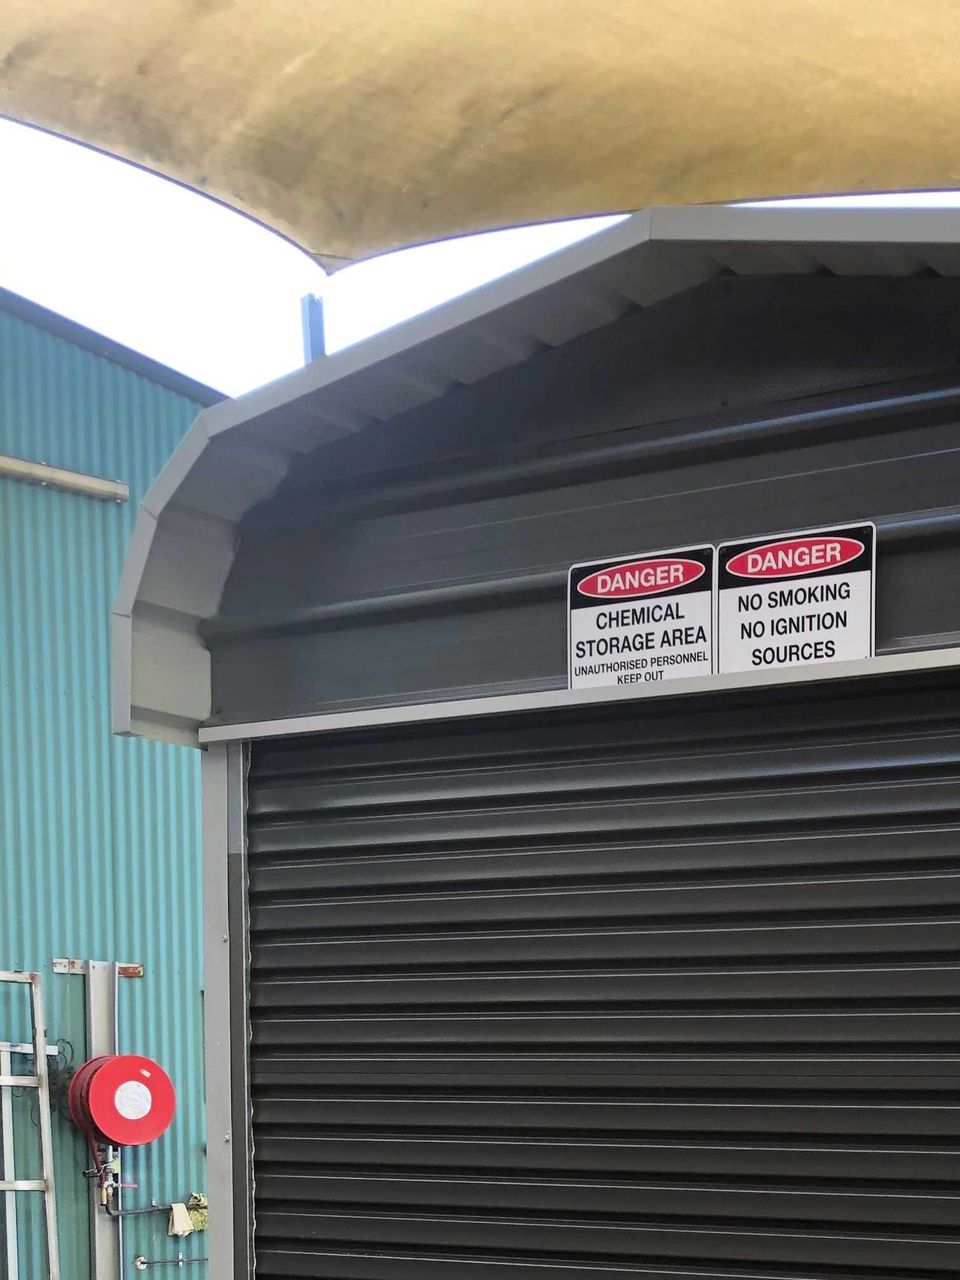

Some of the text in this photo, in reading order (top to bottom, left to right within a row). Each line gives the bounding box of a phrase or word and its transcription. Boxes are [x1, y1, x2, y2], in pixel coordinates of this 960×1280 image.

[747, 542, 841, 574] DANGER
[596, 563, 684, 594] DANGER
[738, 582, 851, 612] NO SMOKING
[596, 602, 685, 630] CHEMICAL
[740, 610, 847, 640] NO IGNITION
[575, 625, 707, 659] STORAGE AREA
[751, 640, 836, 666] SOURCES
[574, 651, 709, 676] UNAUTHORISED PERSONNEL
[617, 670, 664, 685] KEEP OUT
